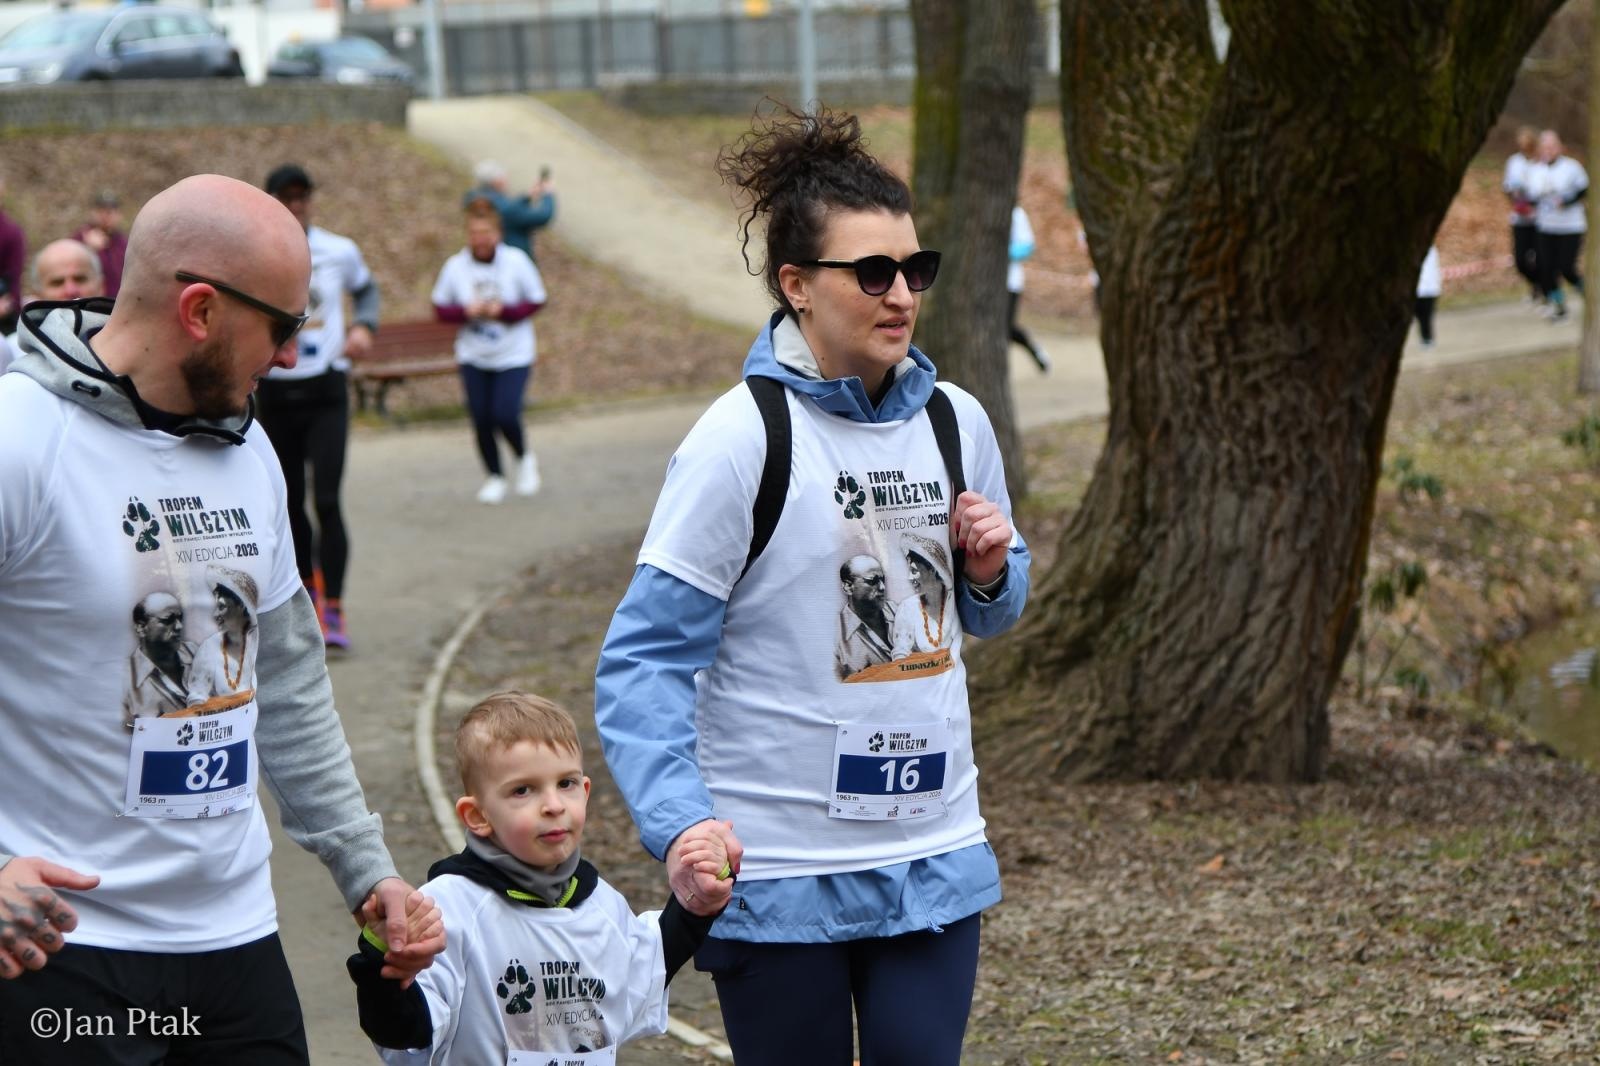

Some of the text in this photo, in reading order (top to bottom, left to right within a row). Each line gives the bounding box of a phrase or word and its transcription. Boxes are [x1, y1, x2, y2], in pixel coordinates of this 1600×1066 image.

[867, 471, 905, 484] TROPEM
[872, 481, 943, 507] WILCZYM
[158, 496, 203, 512] TROPEM
[164, 508, 251, 537] WILCZYM
[876, 512, 949, 532] XIV EDYCJA 2026
[175, 542, 259, 563] XIV EDYCJA 2026
[198, 725, 233, 742] WILCZYM
[199, 720, 219, 730] TROPEM
[889, 732, 911, 740] TROPEM
[889, 738, 927, 751] WILCZYM
[185, 750, 229, 791] 82
[880, 758, 920, 792] 16
[139, 796, 157, 804] 1963
[546, 1013, 562, 1026] XIV
[564, 1009, 597, 1025] EDYCJA
